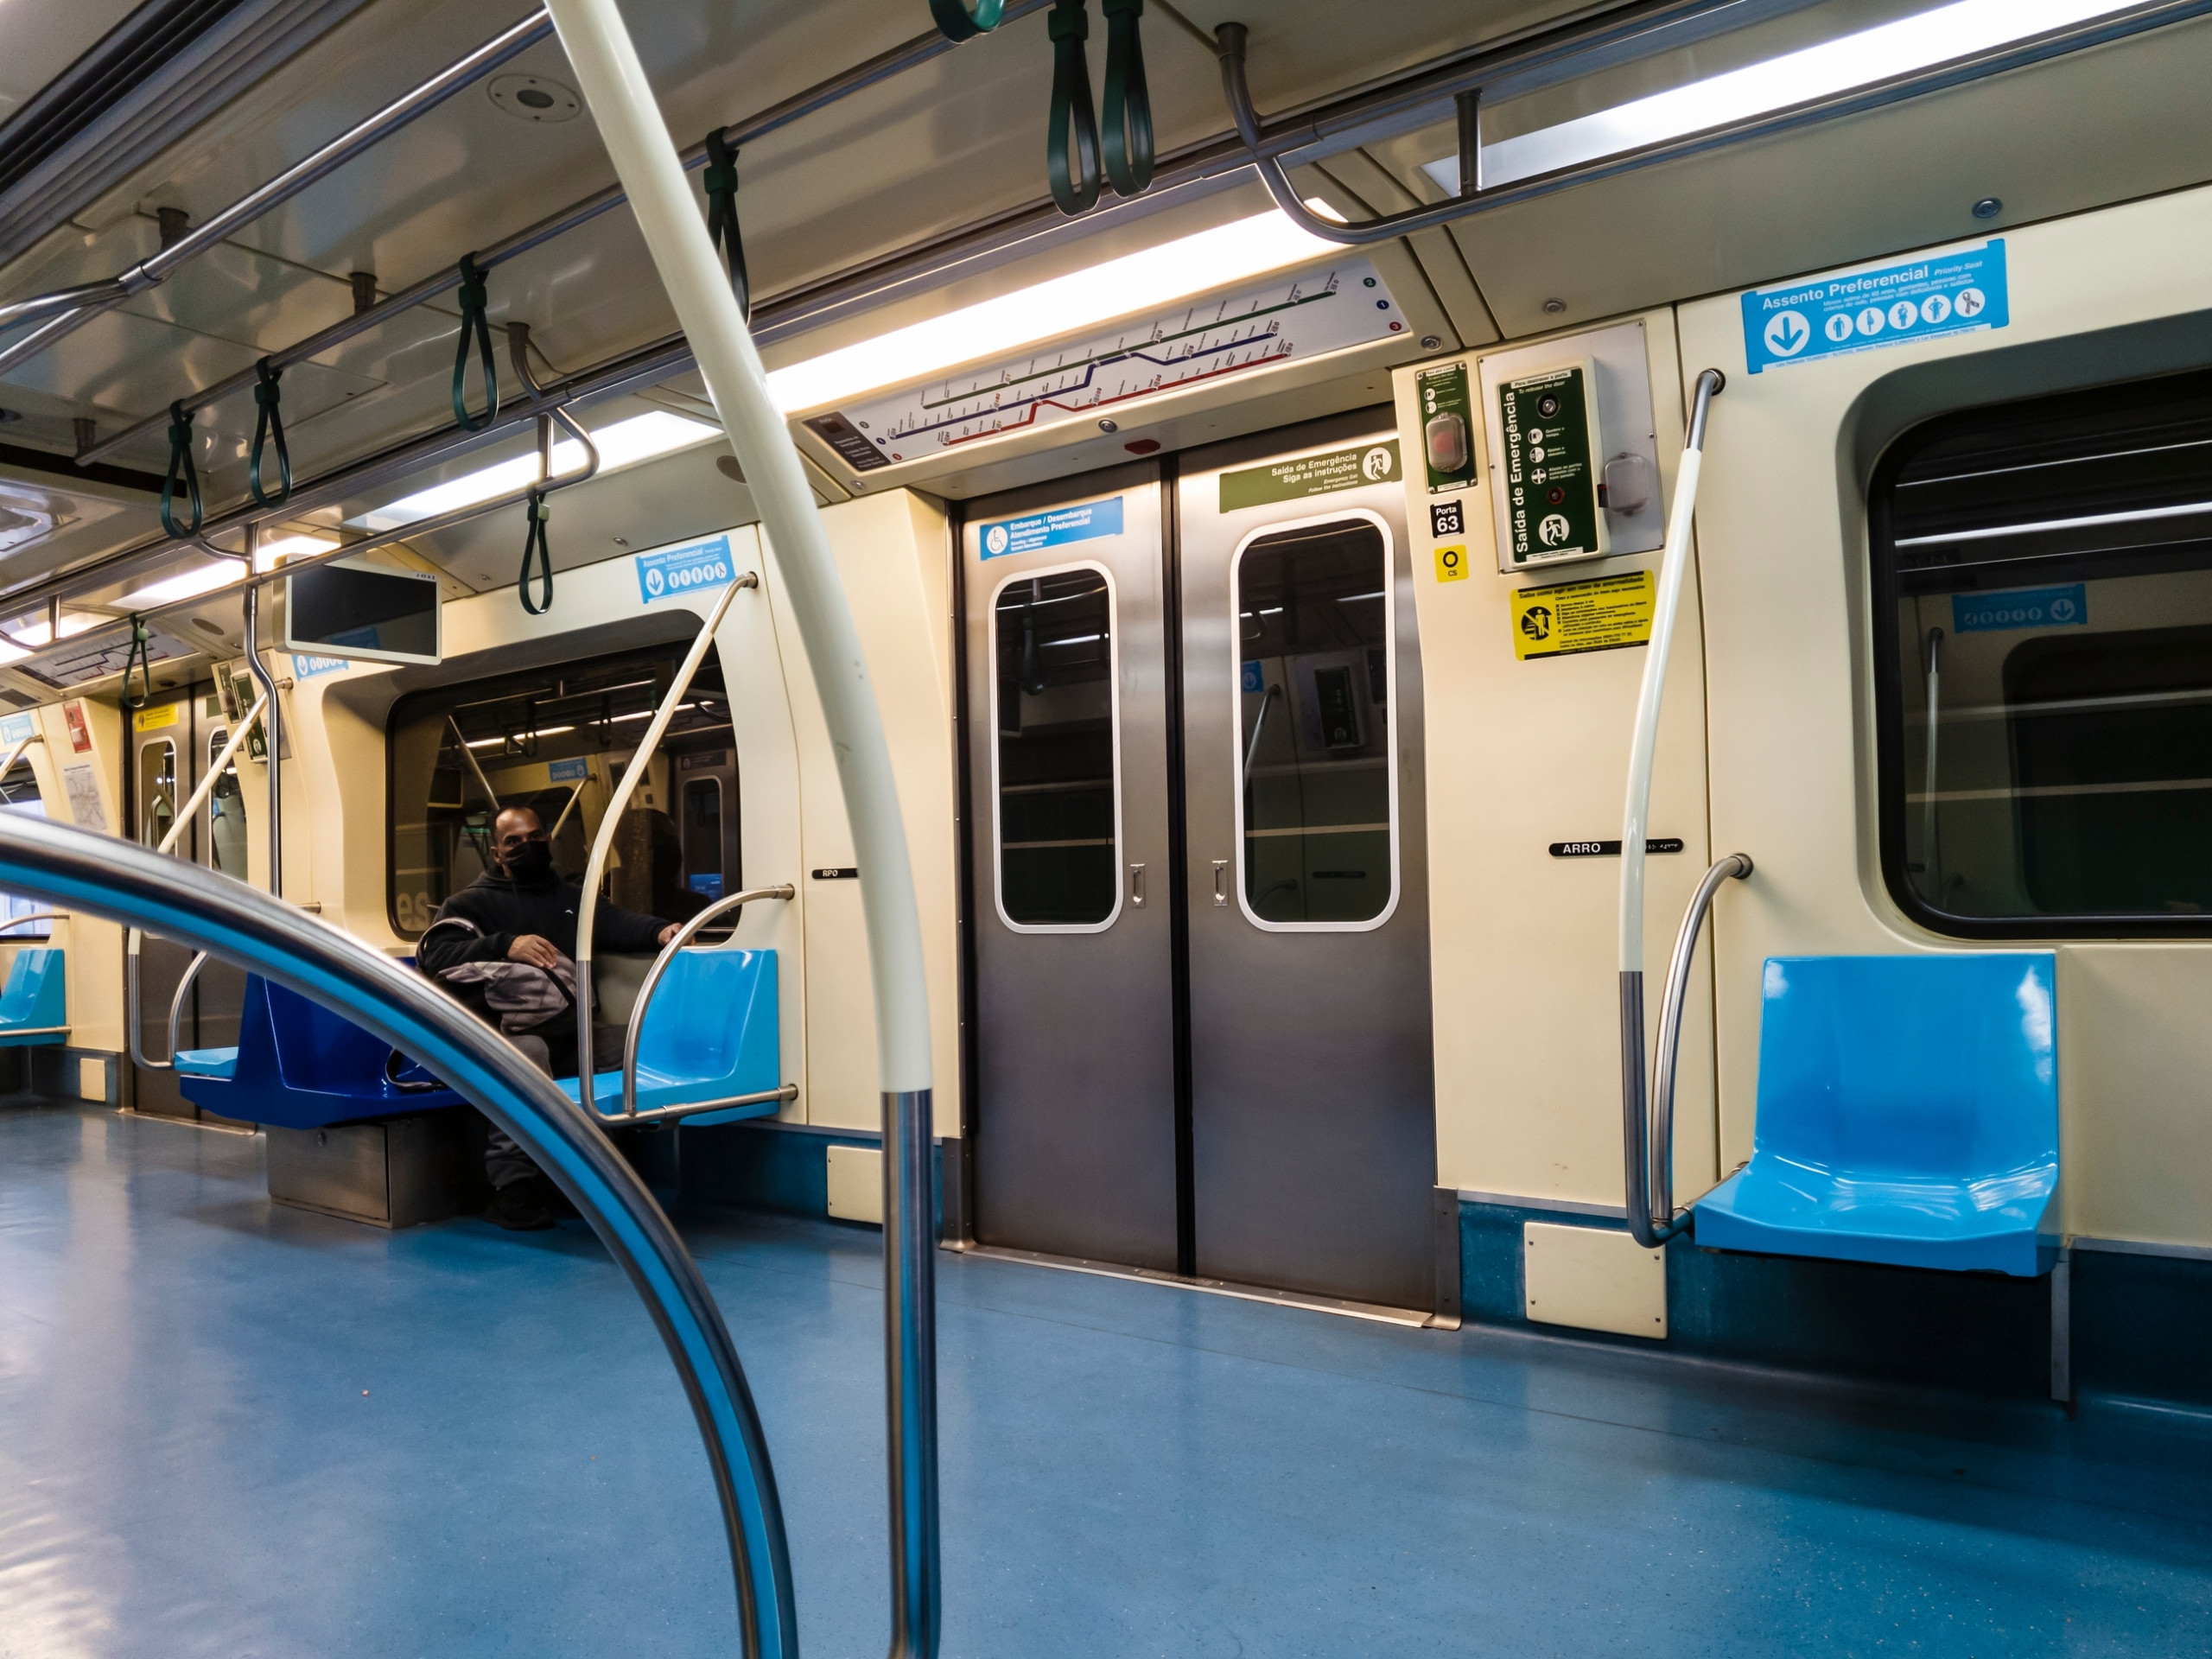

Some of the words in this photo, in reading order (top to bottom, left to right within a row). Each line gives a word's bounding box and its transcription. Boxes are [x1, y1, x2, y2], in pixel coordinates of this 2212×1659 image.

[1934, 264, 1962, 276] Priority
[1964, 260, 1982, 270] Seat
[1763, 288, 1824, 310] Assento
[1829, 265, 1929, 296] Preferencial
[1504, 392, 1522, 483] Emergência
[1271, 465, 1294, 475] Saída
[1296, 462, 1306, 471] de
[1308, 452, 1357, 469] Emergência
[1283, 472, 1300, 484] Siga
[1314, 461, 1357, 477] instruções
[1512, 487, 1524, 505] de
[1010, 518, 1041, 530] Embarque
[1047, 507, 1091, 523] Desembarque
[1436, 506, 1457, 516] Porta
[1010, 525, 1049, 538] Atendimento
[1051, 517, 1090, 530] Preferencial
[1437, 516, 1459, 532] 63
[1514, 510, 1528, 553] Saída
[1562, 842, 1601, 854] ARRO
